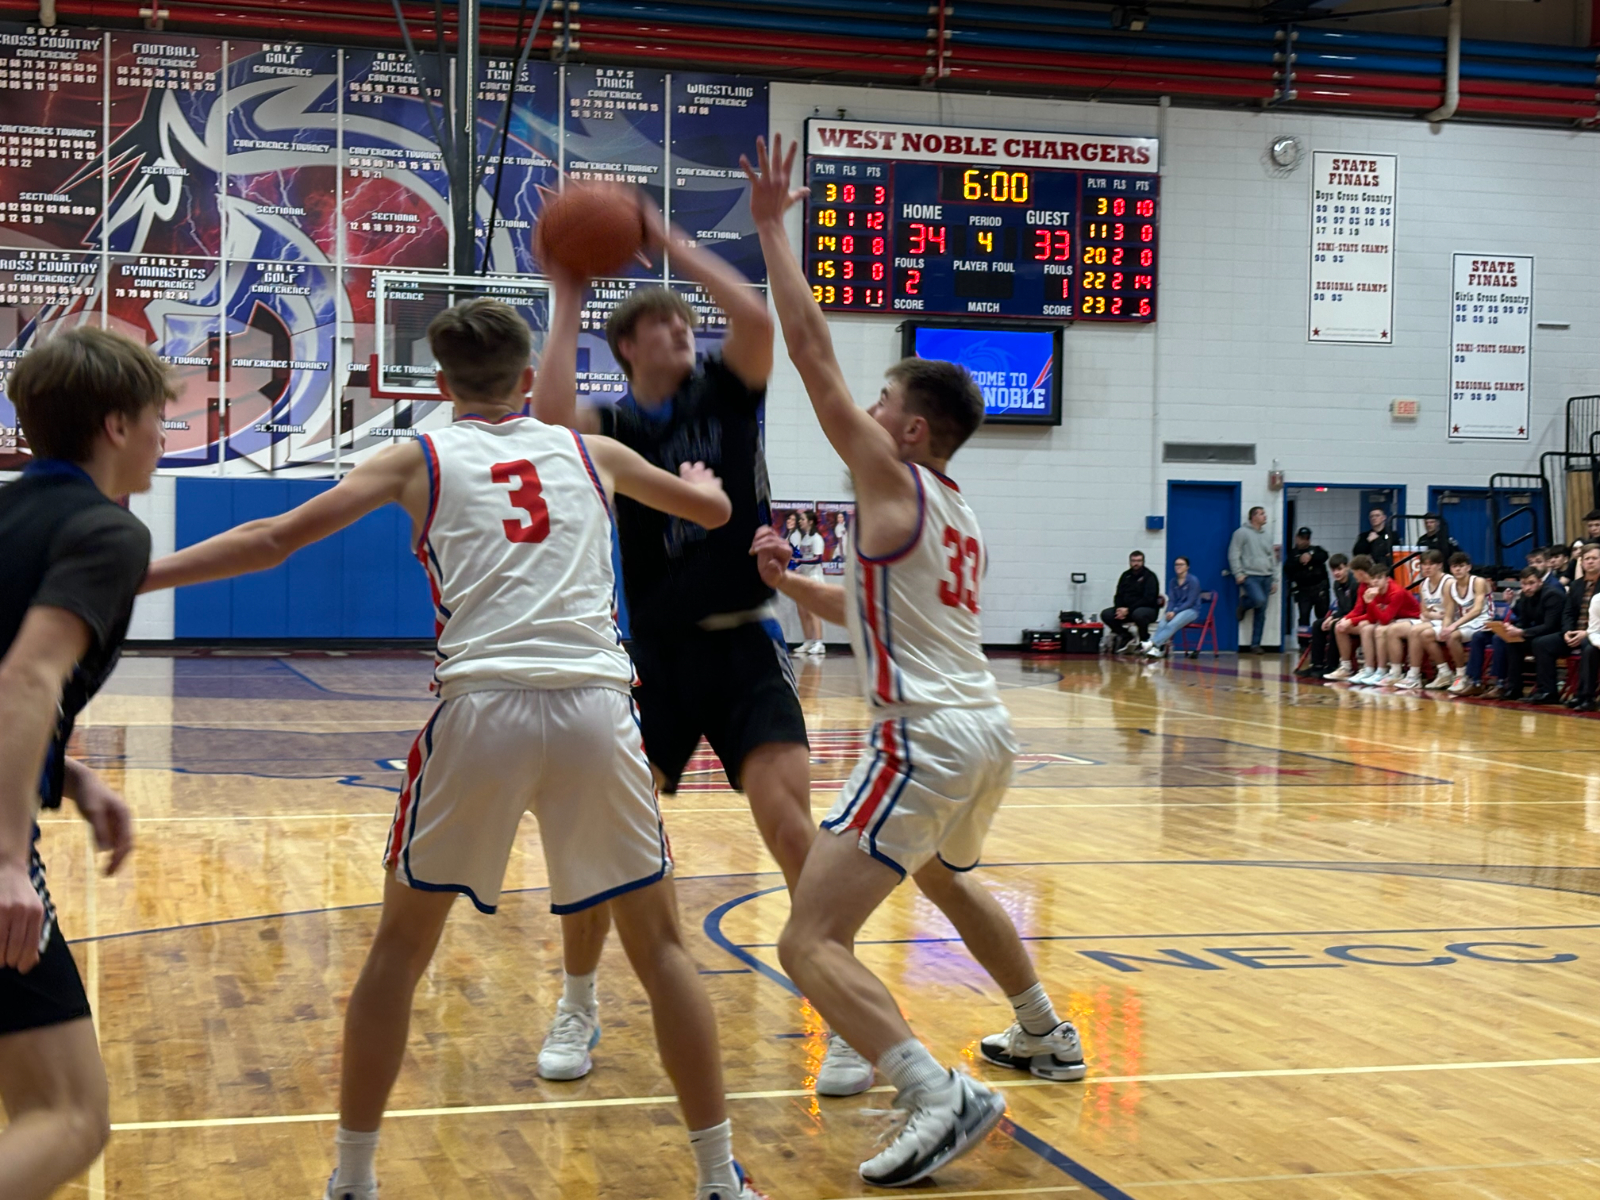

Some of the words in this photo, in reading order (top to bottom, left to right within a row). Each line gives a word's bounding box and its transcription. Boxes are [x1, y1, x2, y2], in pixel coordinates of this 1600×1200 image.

[26, 26, 70, 37] BOYS
[40, 37, 100, 51] COUNTRY
[262, 44, 304, 54] BOYS
[16, 49, 78, 60] CONFERENCE
[132, 43, 200, 58] FOOTBALL
[136, 57, 197, 68] CONFERENCE
[265, 52, 299, 65] GOLF
[253, 65, 313, 76] CONFERENCE
[596, 68, 634, 78] BOYS
[596, 77, 634, 89] TRACK
[588, 90, 643, 100] CONFERENCE
[687, 84, 753, 97] WRESTLING
[694, 96, 747, 107] CONFERENCE
[56, 128, 96, 138] TOURNEY
[233, 138, 289, 150] CONFERENCE
[291, 142, 330, 154] TOURNEY
[817, 127, 896, 151] WEST
[902, 133, 997, 157] NOBLE
[1002, 139, 1151, 164] CHARGERS
[349, 147, 404, 157] CONFERENCE
[405, 150, 442, 159] TOURNEY
[141, 166, 189, 176] SECTIONAL
[570, 161, 621, 171] CONFERENCE
[624, 164, 659, 174] TOURNEY
[815, 163, 835, 174] PLYR
[842, 165, 856, 176] FLS
[866, 167, 881, 177] PTS
[1332, 159, 1376, 172] STATE
[676, 167, 726, 178] CONFERENCE
[1087, 178, 1106, 188] PLYR
[1113, 179, 1126, 190] FLS
[1136, 181, 1149, 191] PTS
[1329, 173, 1379, 187] FINALS
[964, 170, 1028, 203] 6:00
[19, 192, 72, 203] SECTIONAL
[826, 183, 837, 202] 3
[843, 184, 855, 203] 0
[875, 186, 885, 204] 3
[1316, 190, 1333, 202] Boys
[1337, 191, 1359, 201] Cross
[1362, 192, 1392, 205] Country
[256, 205, 307, 216] SECTIONAL
[903, 204, 943, 220] HOME
[1098, 198, 1108, 215] 3
[1114, 198, 1126, 216] 0
[1136, 199, 1154, 217] 10
[371, 212, 420, 222] SECTIONAL
[818, 209, 836, 227] 10
[848, 212, 854, 226] 1
[867, 211, 884, 229] 12
[969, 216, 1002, 226] PERIOD
[1026, 210, 1070, 226] GUEST
[1365, 218, 1374, 226] 10
[697, 231, 741, 240] SECTIONAL
[909, 223, 946, 254] 34
[1090, 223, 1107, 238] 11
[1114, 223, 1124, 240] 3
[1141, 224, 1153, 242] 0
[818, 236, 836, 251] 14
[842, 235, 854, 253] 0
[978, 232, 993, 252] 4
[1034, 230, 1070, 261] 33
[1317, 242, 1359, 252] SEMI-STATE
[1361, 244, 1388, 254] CHAMPS
[20, 251, 70, 260] GIRLS
[1083, 247, 1106, 264] 20
[1112, 247, 1124, 265] 2
[1141, 248, 1153, 267] 0
[0, 259, 34, 271] ROSS
[38, 261, 98, 274] COUNTRY
[140, 257, 189, 267] GIRLS
[894, 257, 925, 269] FOULS
[953, 260, 988, 272] PLAYER
[992, 262, 1016, 272] FOUL
[1472, 260, 1515, 273] STATE
[122, 265, 206, 279] GYMNASTICS
[257, 264, 305, 273] GIRLS
[818, 260, 835, 278] 15
[843, 260, 854, 279] 3
[872, 262, 884, 281] 0
[1044, 265, 1073, 275] FOULS
[14, 273, 76, 283] CONFERENCE
[134, 279, 194, 289] CONFERENCE
[264, 272, 298, 284] GOLF
[905, 270, 921, 295] 2
[1083, 272, 1106, 289] 22
[1112, 272, 1124, 290] 2
[1134, 275, 1152, 289] 14
[1468, 274, 1517, 287] FINALS
[251, 284, 310, 295] CONFERENCE
[591, 280, 636, 289] GIRLS
[1062, 278, 1069, 299] 1
[1316, 281, 1354, 291] REGIONAL
[1357, 283, 1388, 293] CHAMPS
[812, 285, 835, 304] 33
[843, 286, 854, 304] 3
[866, 289, 883, 304] 11
[1455, 292, 1474, 301] Girls
[1477, 292, 1497, 302] Cross
[1500, 294, 1529, 306] Country
[894, 299, 924, 310] SCORE
[968, 302, 1000, 313] MATCH
[1043, 305, 1073, 316] SCORE
[1082, 296, 1105, 314] 23
[1111, 297, 1122, 314] 2
[1139, 298, 1151, 316] 6
[1498, 345, 1526, 354] CHAMPS
[231, 358, 288, 369] CONFERENCE
[290, 361, 328, 370] TOURNEY
[970, 370, 1006, 386] COME
[1010, 372, 1027, 387] TO
[1455, 381, 1492, 390] REGIONAL
[1494, 382, 1525, 391] CHAMPS
[983, 387, 1046, 409] NOBLE
[254, 424, 306, 434] SETIONAL
[369, 427, 419, 437] SECTIONAL
[490, 458, 550, 544] 3
[938, 524, 981, 615] 33
[1076, 942, 1579, 974] NECC
